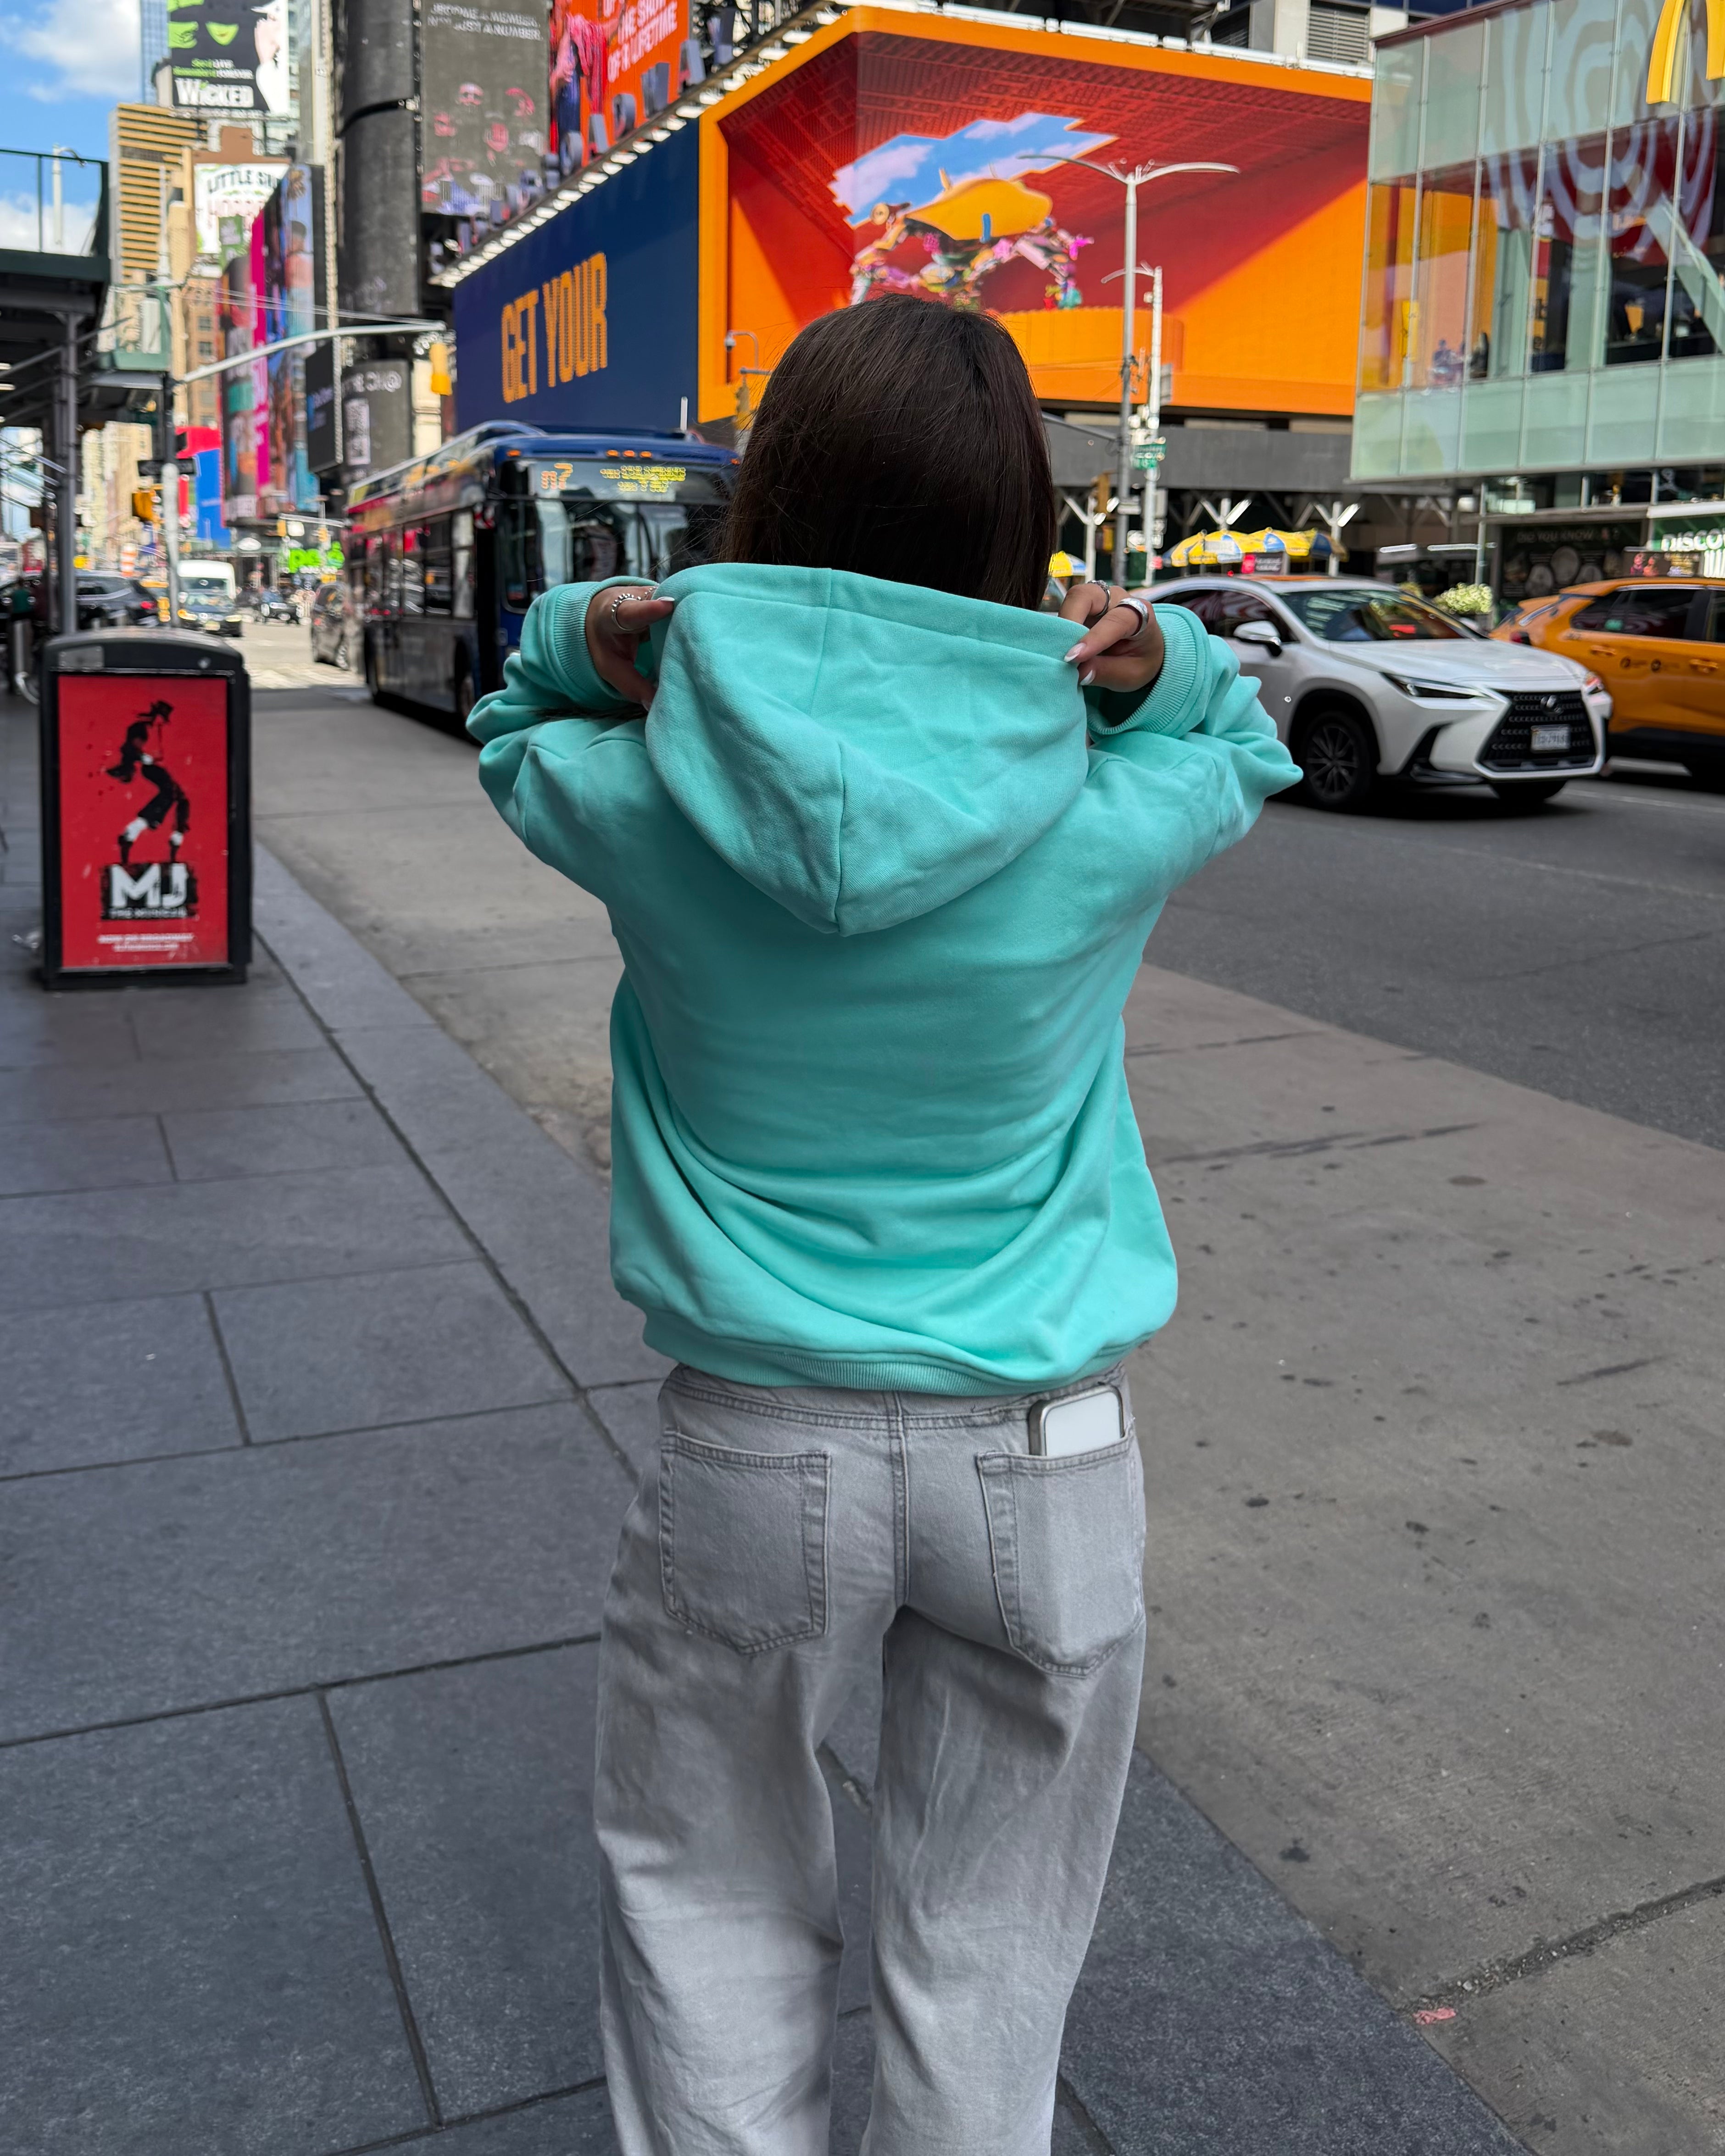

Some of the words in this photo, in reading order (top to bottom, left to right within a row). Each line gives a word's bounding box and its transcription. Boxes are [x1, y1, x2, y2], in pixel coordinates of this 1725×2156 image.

[206, 168, 253, 194] LITTLE
[501, 289, 539, 403] GET
[542, 251, 607, 387] YOUR
[1537, 531, 1558, 543] YOU
[1661, 528, 1725, 552] DISCO
[111, 863, 188, 908] MJ
